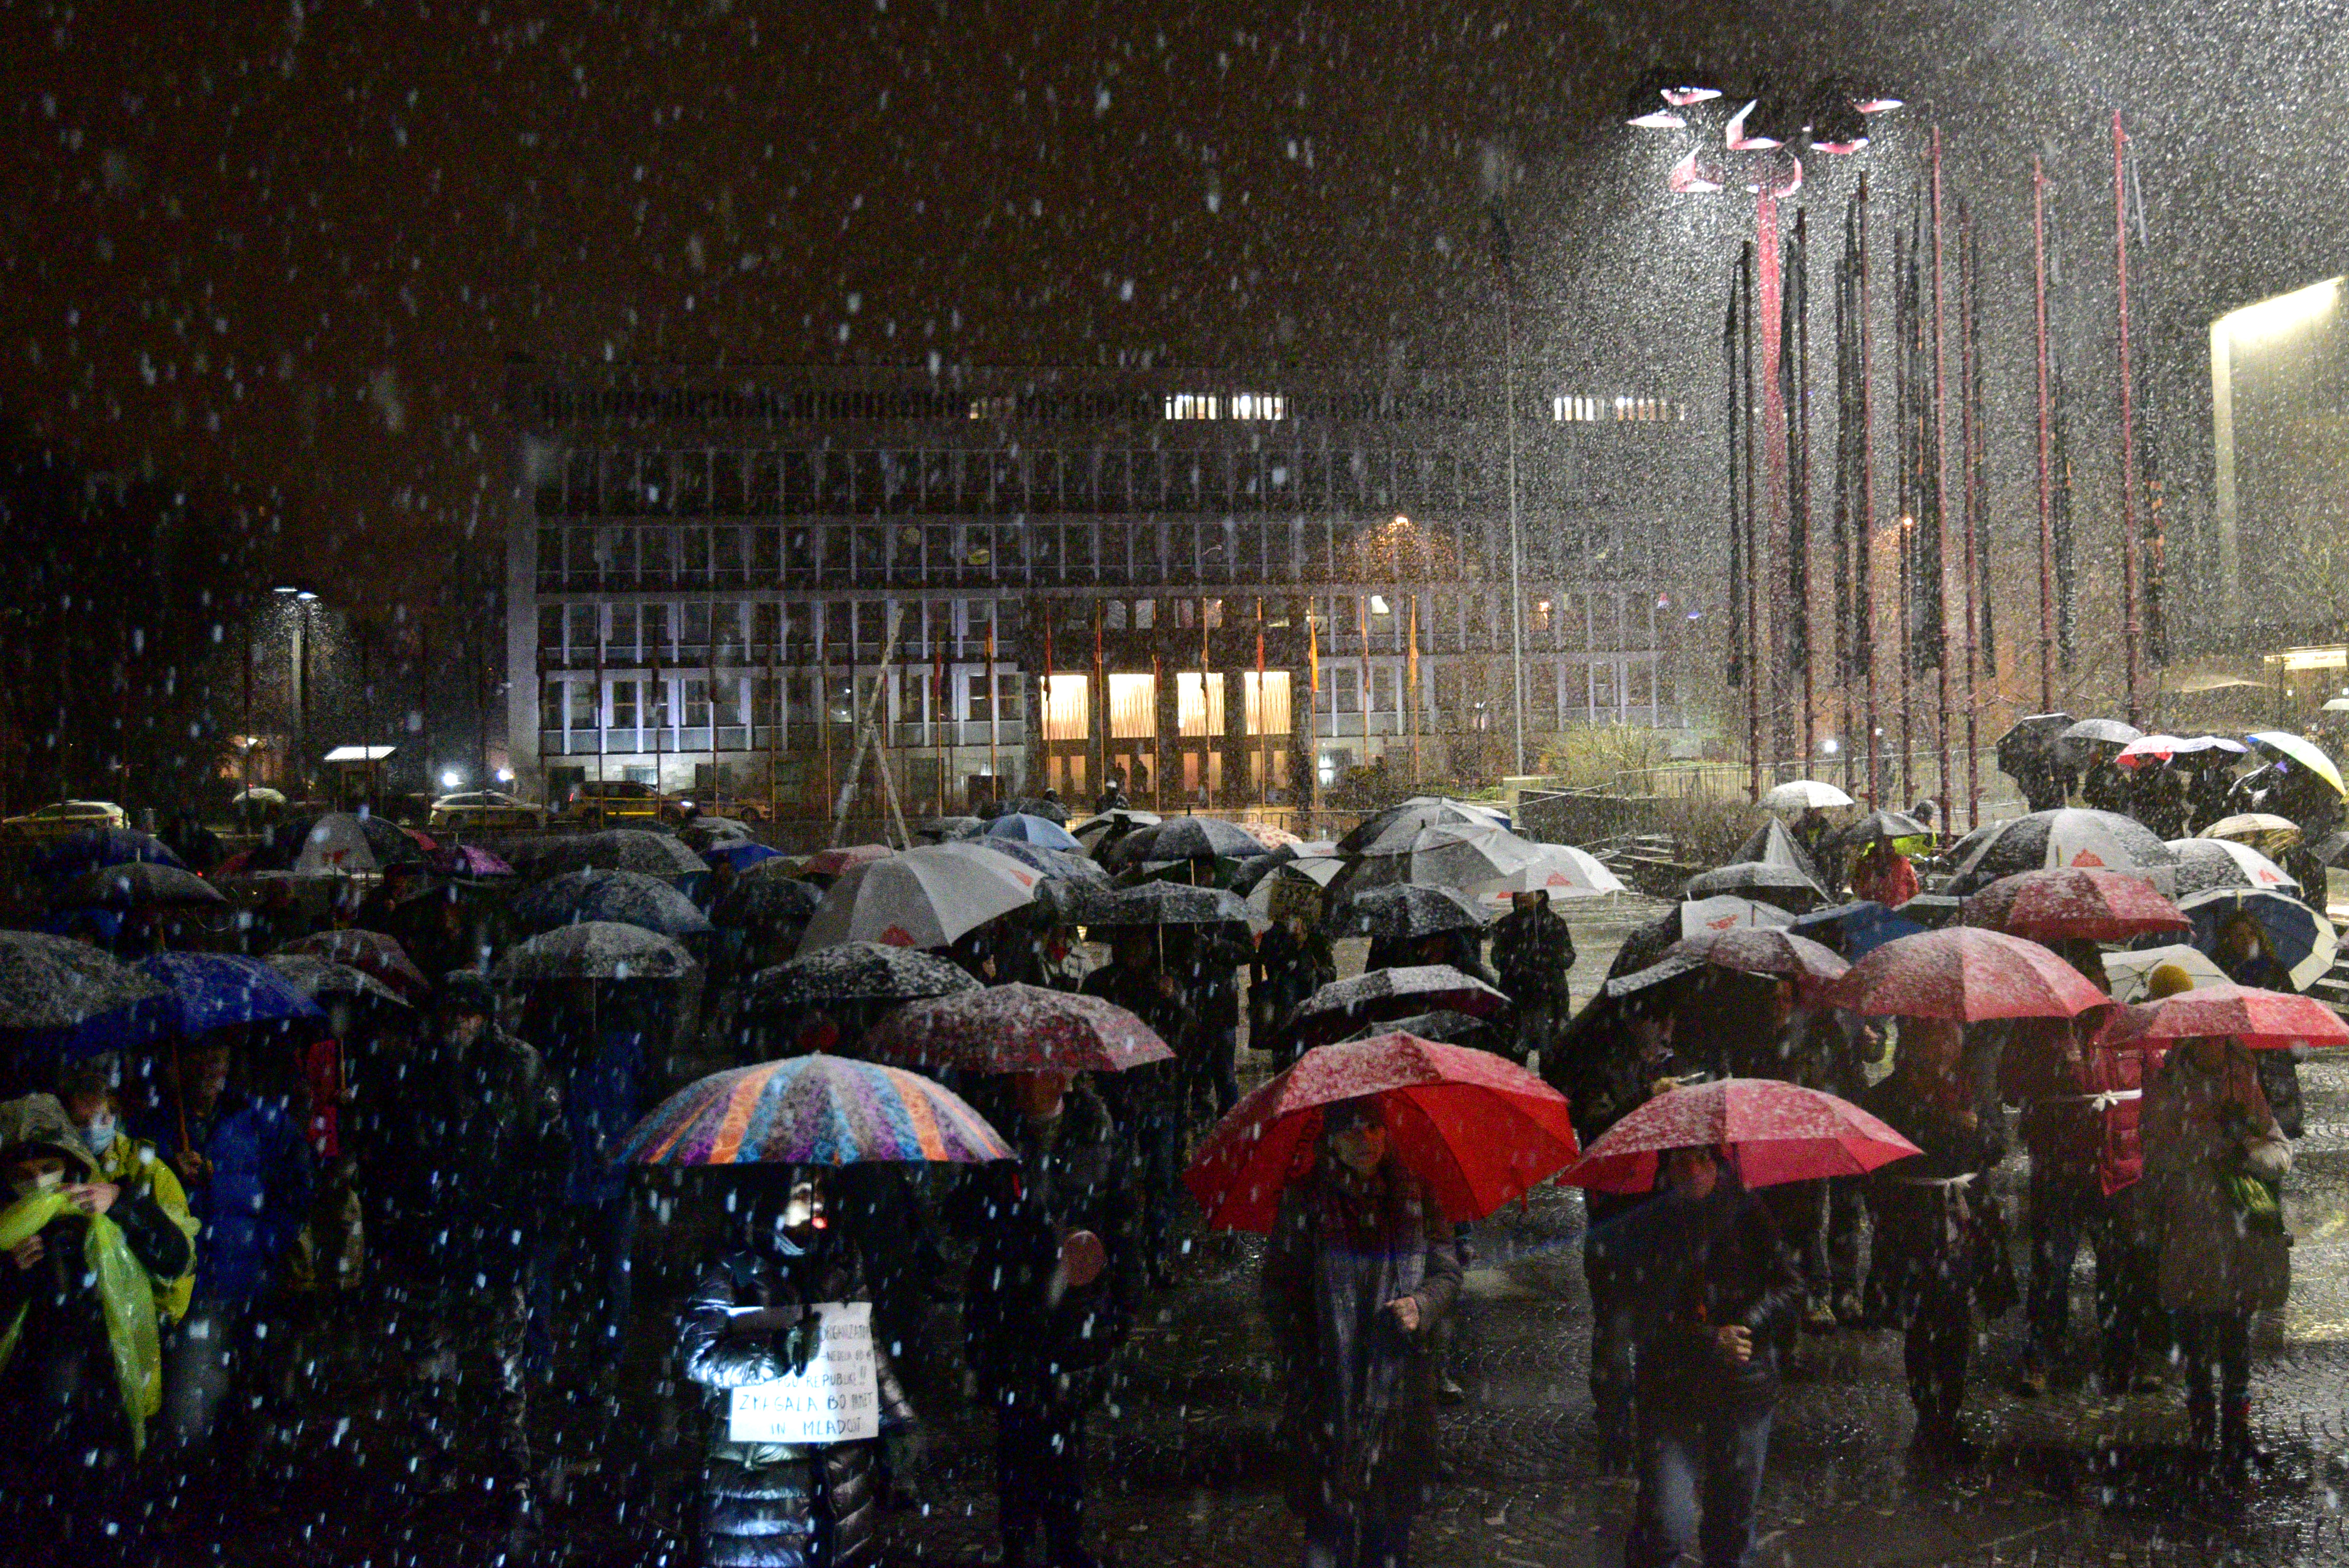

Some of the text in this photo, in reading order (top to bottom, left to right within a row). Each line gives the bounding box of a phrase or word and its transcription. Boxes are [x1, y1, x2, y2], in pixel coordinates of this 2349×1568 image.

[739, 1394, 817, 1411] ZMAGALA
[828, 1394, 846, 1410] BO
[770, 1422, 786, 1435] IN
